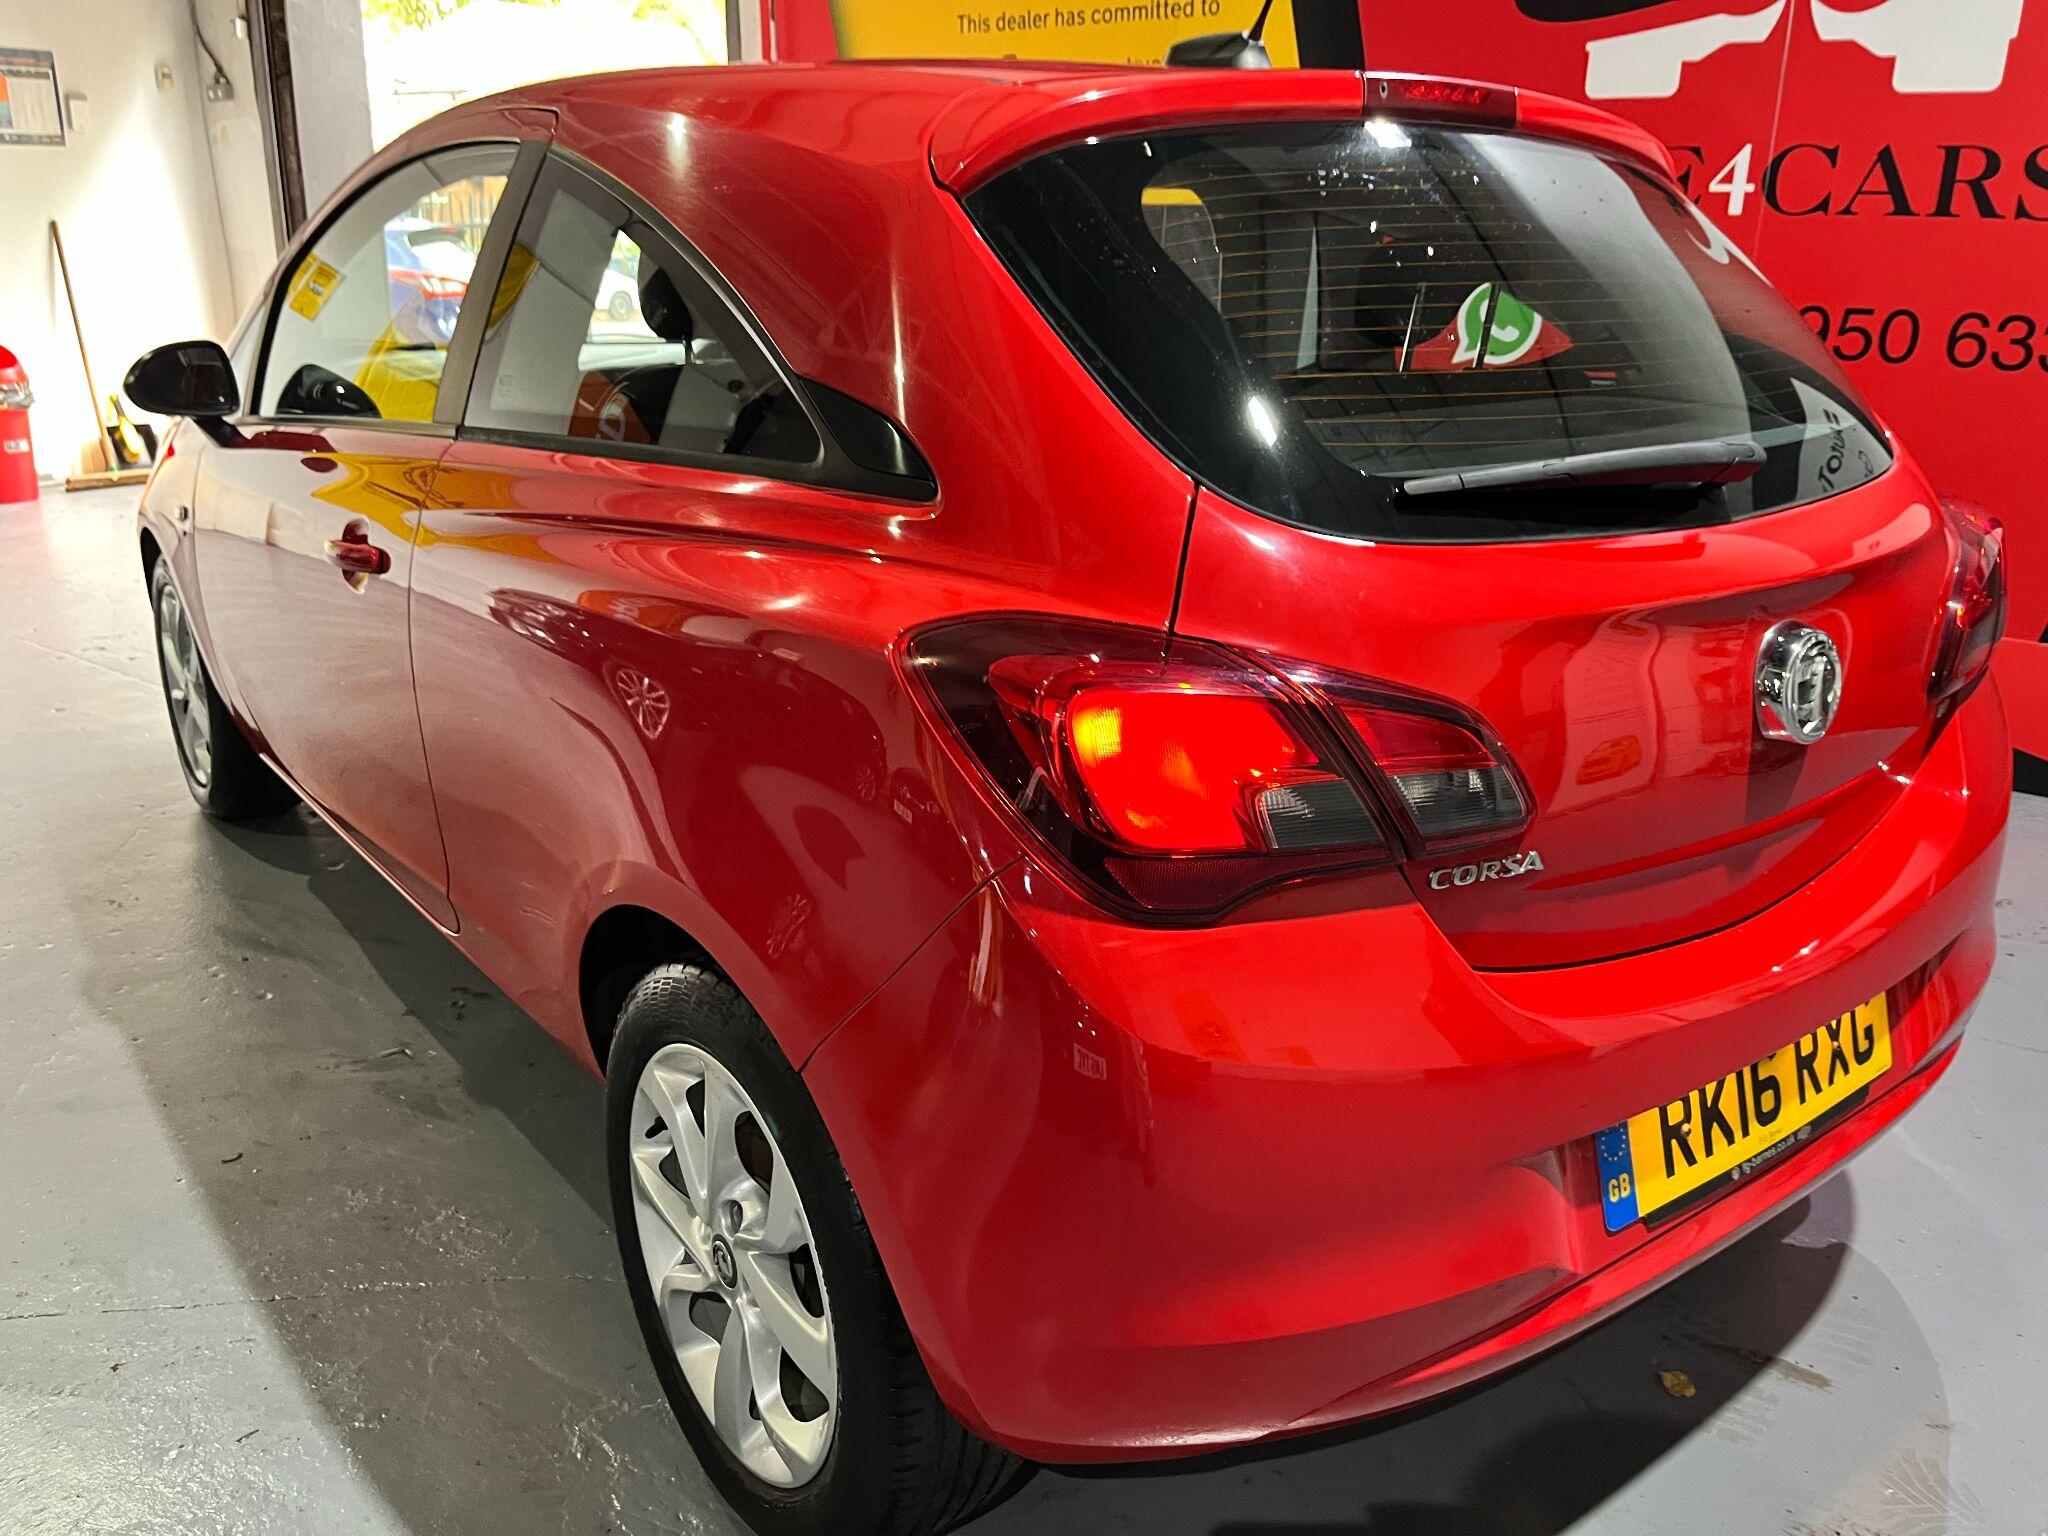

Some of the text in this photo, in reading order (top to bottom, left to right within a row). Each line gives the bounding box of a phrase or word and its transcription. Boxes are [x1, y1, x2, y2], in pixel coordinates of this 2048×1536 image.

[957, 0, 1220, 34] This dealer has committed to
[1946, 312, 2048, 373] 63
[1429, 850, 1544, 890] CORSA
[1658, 1002, 1876, 1179] RK16 RXG
[1608, 1173, 1631, 1203] GB
